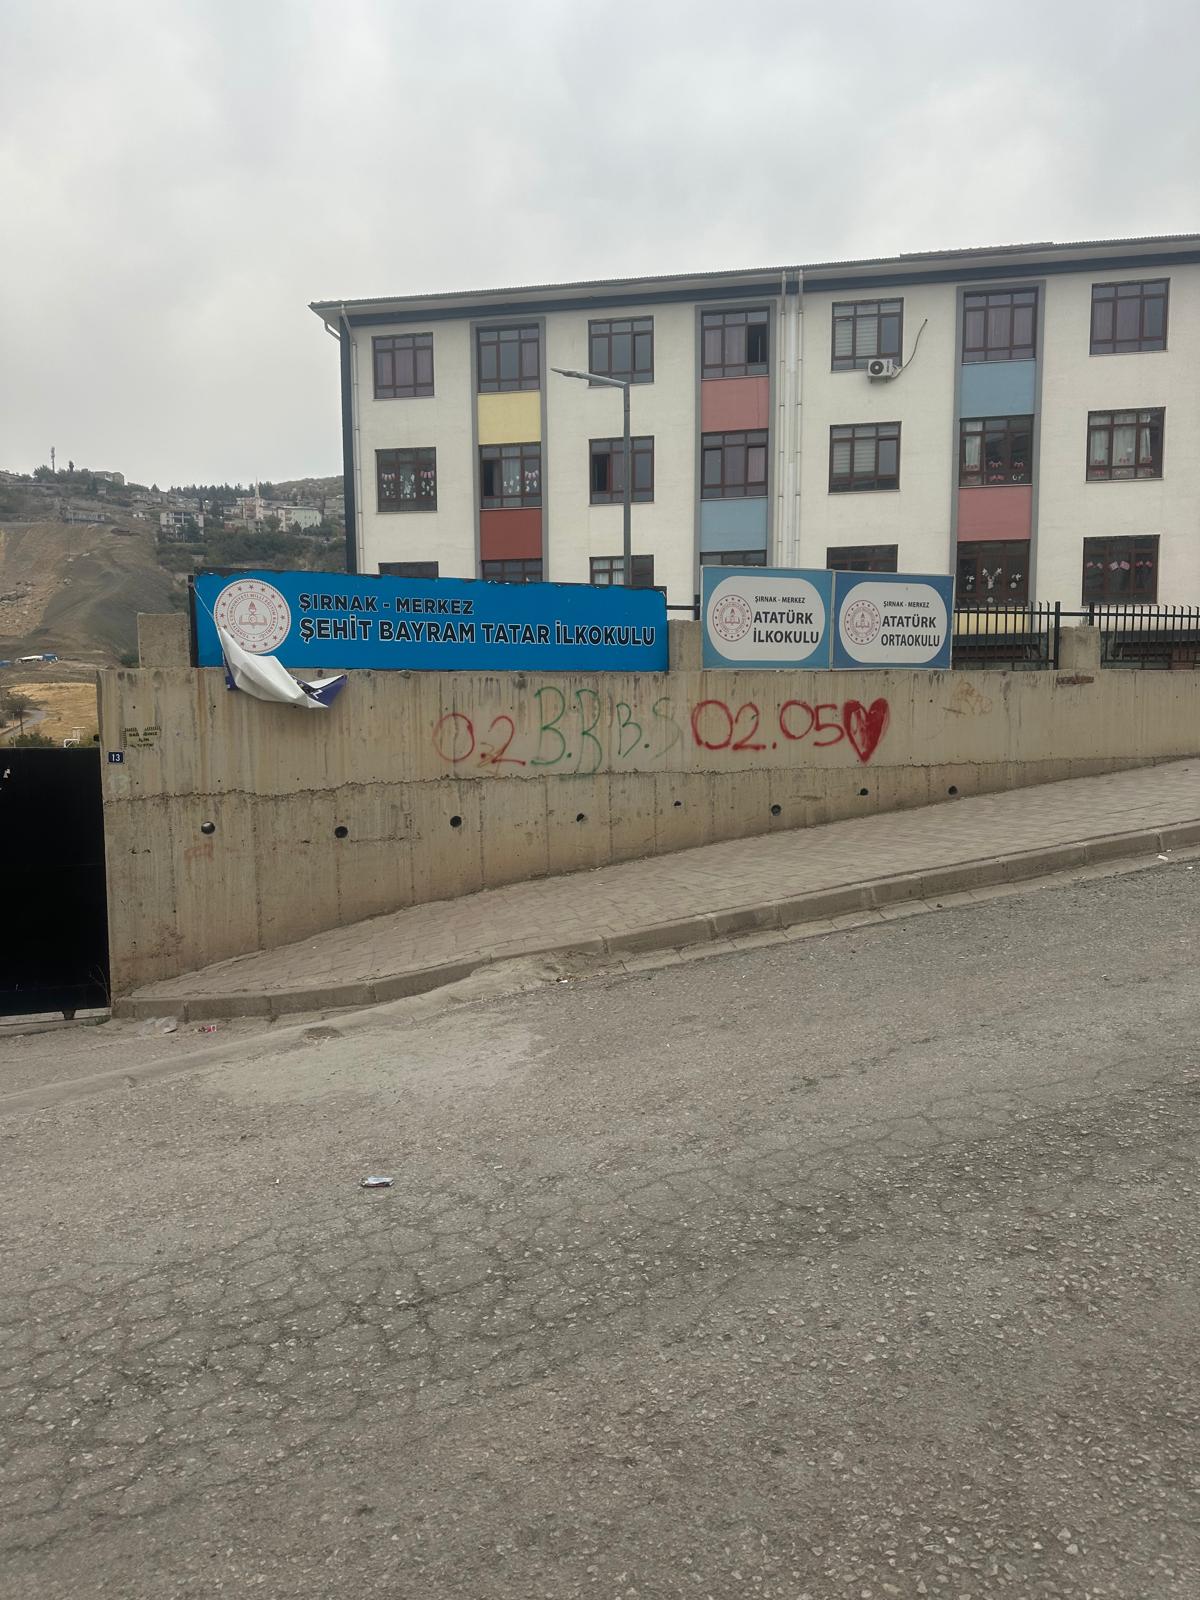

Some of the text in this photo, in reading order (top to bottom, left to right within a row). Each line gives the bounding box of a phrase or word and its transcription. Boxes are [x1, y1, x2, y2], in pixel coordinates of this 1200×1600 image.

[299, 593, 378, 613] ŞIRNAK
[396, 597, 474, 615] MERKEZ
[754, 595, 777, 604] ŞIRNAK
[883, 600, 904, 608] ŞIRNAK
[753, 609, 813, 624] ATATÜRK
[882, 614, 937, 628] ATATÜRK
[300, 614, 656, 647] ŞEHİT BAYRAM TATAR İLKOKULU
[753, 628, 819, 643] İLKOKULU
[881, 634, 940, 647] ORTAOKULU
[111, 753, 121, 762] 13
